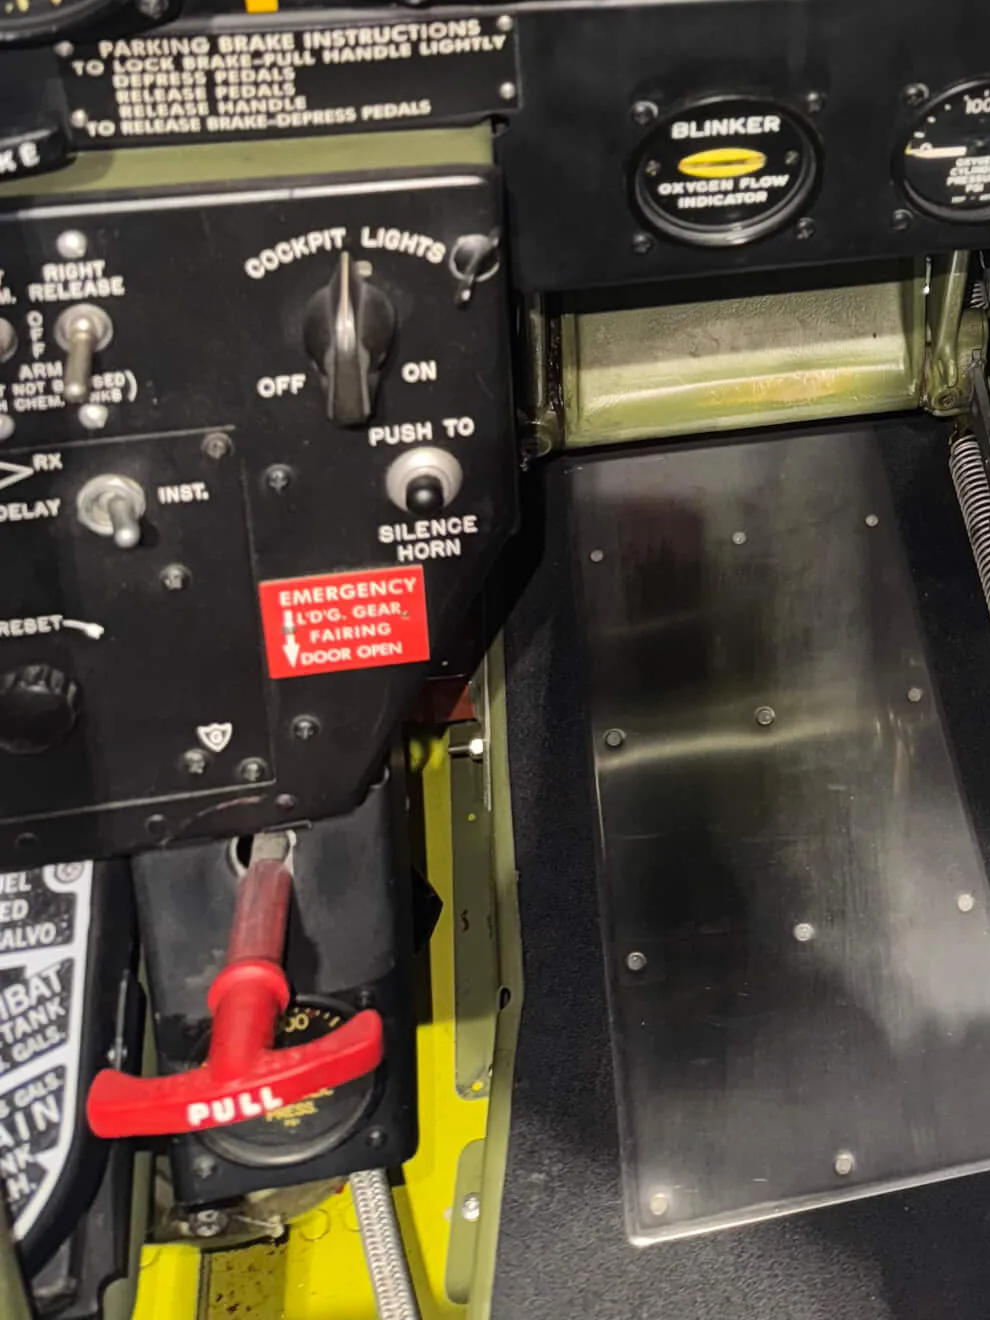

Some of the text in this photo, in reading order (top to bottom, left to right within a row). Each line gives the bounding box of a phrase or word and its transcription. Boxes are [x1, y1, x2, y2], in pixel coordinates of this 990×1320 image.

[99, 18, 481, 59] PARKING BRAKE INSTRUCTIONS
[72, 34, 506, 76] TO LOCK BRAKE-PULL HANDLE LIGHTLY
[112, 66, 296, 89] DEPRESS PEDALS
[115, 81, 296, 104] RELEASE PEDALS
[86, 99, 432, 138] TO RELEASE BRAKE-DEPRESS PEDALS
[118, 95, 307, 119] RELEASE HANDLE
[671, 115, 781, 140] BLINKER
[657, 174, 790, 196] OXYGEN FLOW
[677, 190, 769, 209] INDICATOR
[244, 226, 447, 280] COCKPIT LIGHTS
[42, 259, 106, 282] RIGHT
[28, 275, 126, 302] RELEASE
[18, 360, 63, 381] ARM
[402, 360, 437, 383] ON
[11, 381, 46, 396] NOT
[257, 373, 306, 398] OFF
[13, 395, 66, 412] CHEM.
[368, 416, 475, 447] PUSH TO
[32, 452, 63, 472] RX
[158, 482, 209, 504] INST.
[378, 515, 478, 543] SILENCE
[396, 538, 462, 562] HORN
[279, 577, 416, 607] EMERGENCY
[310, 622, 391, 643] FAIRING
[300, 641, 403, 666] DOOR OPEN
[187, 1085, 284, 1126] PULL
